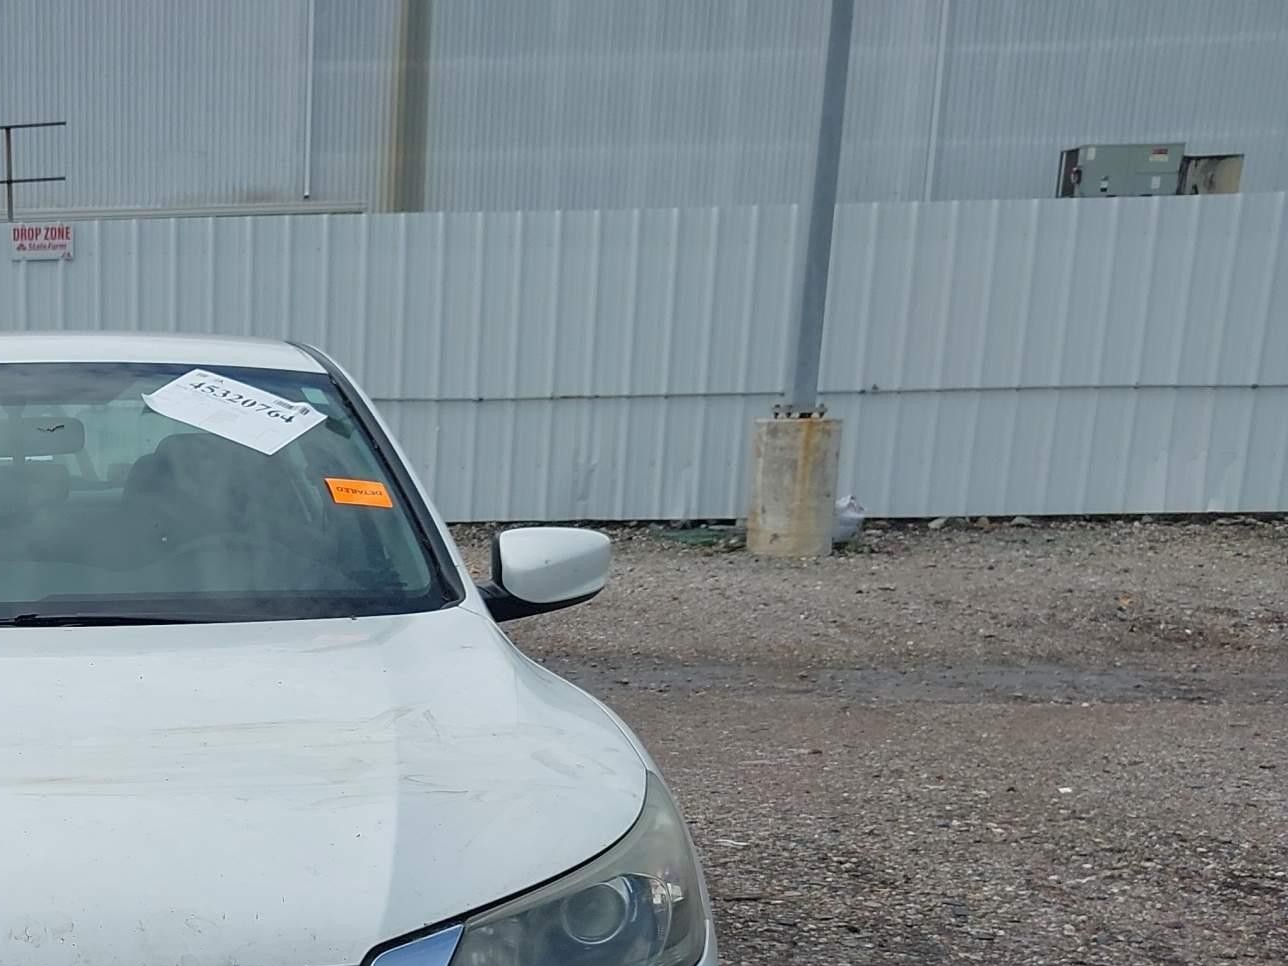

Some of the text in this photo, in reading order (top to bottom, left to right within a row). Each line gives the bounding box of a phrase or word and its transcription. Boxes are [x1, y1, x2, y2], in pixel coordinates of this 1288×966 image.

[13, 225, 71, 241] DROP ZONE
[189, 382, 295, 424] 45320764
